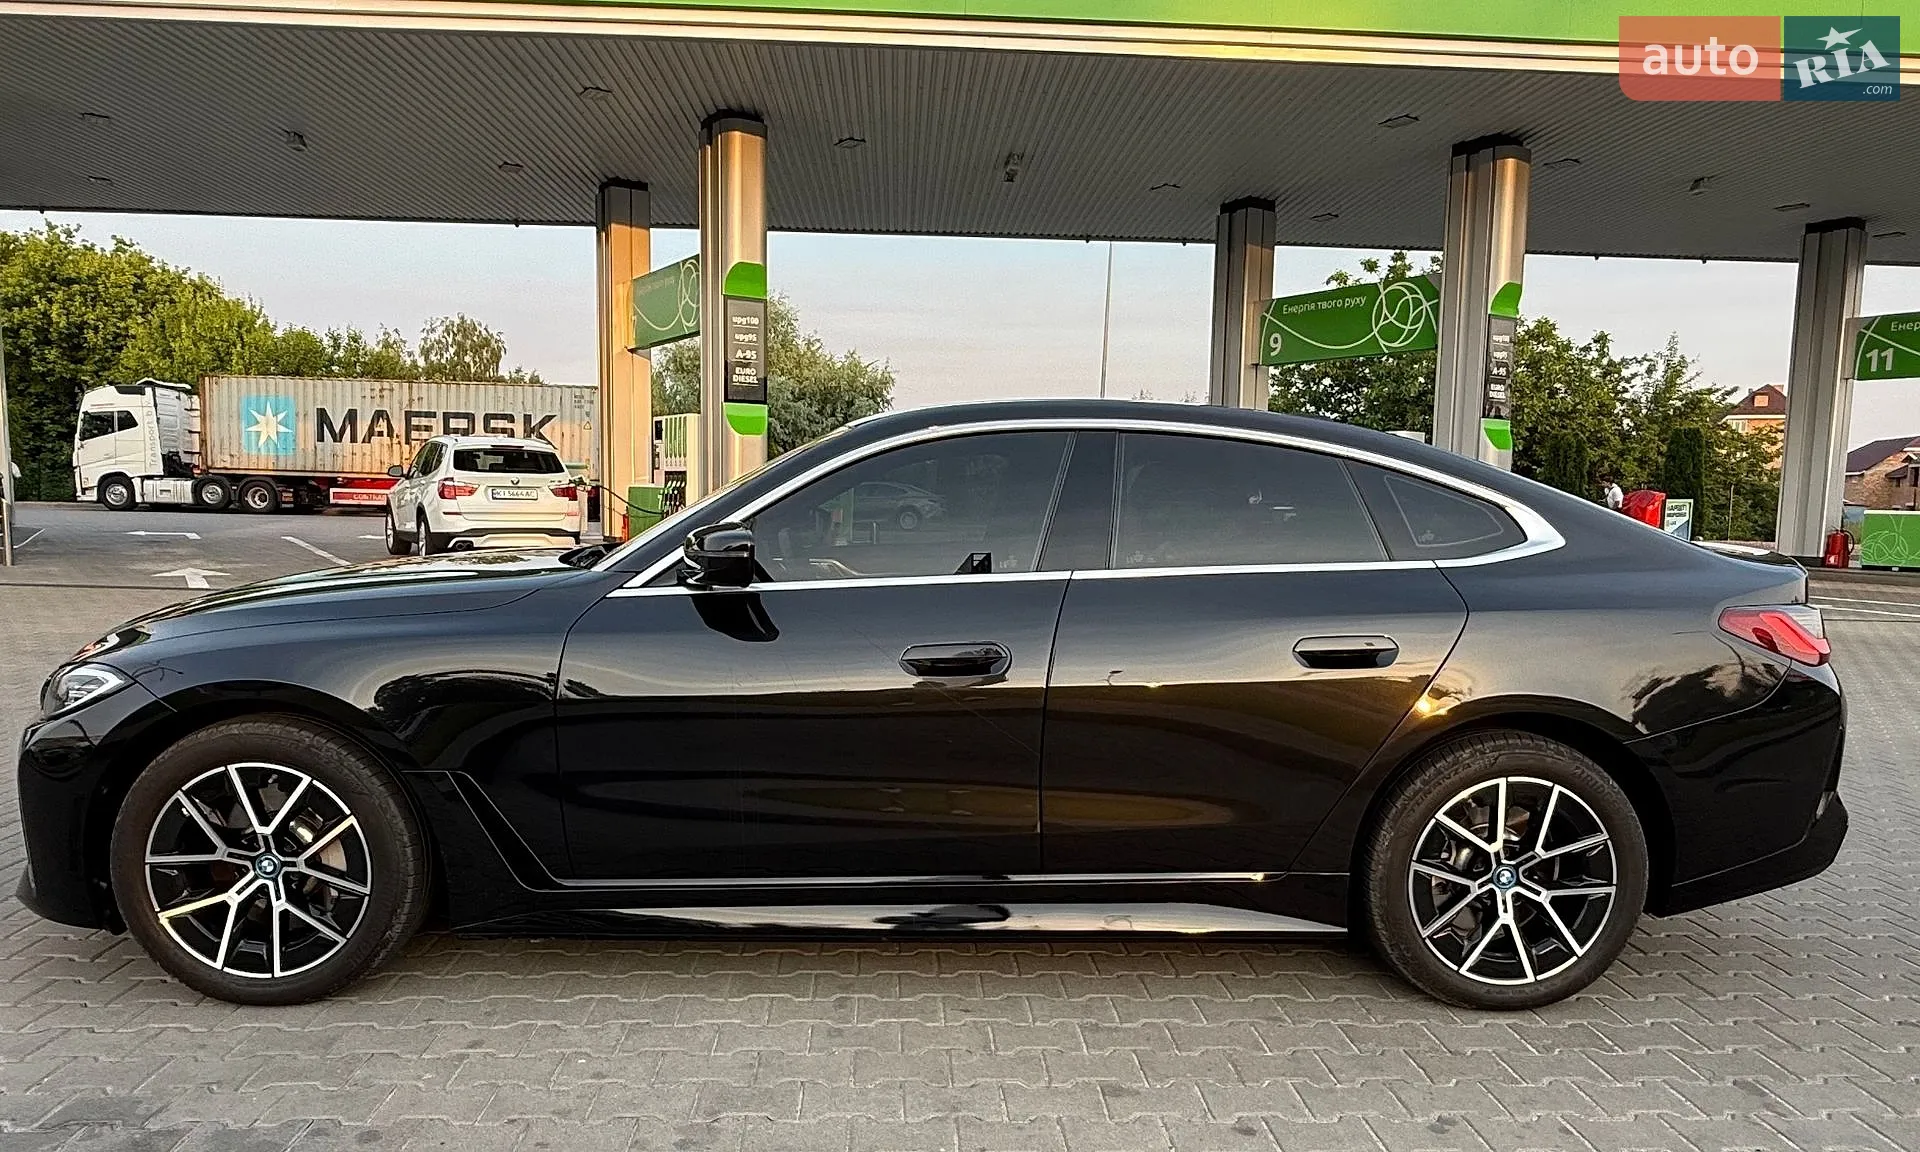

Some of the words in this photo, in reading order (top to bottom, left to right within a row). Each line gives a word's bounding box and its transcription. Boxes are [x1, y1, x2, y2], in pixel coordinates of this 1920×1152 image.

[1317, 298, 1343, 310] твого
[1344, 295, 1367, 309] руху
[1269, 332, 1282, 357] 9
[1865, 347, 1894, 372] 11
[732, 374, 759, 384] DIESEL
[735, 366, 757, 376] EURO
[316, 407, 558, 450] MAERSK
